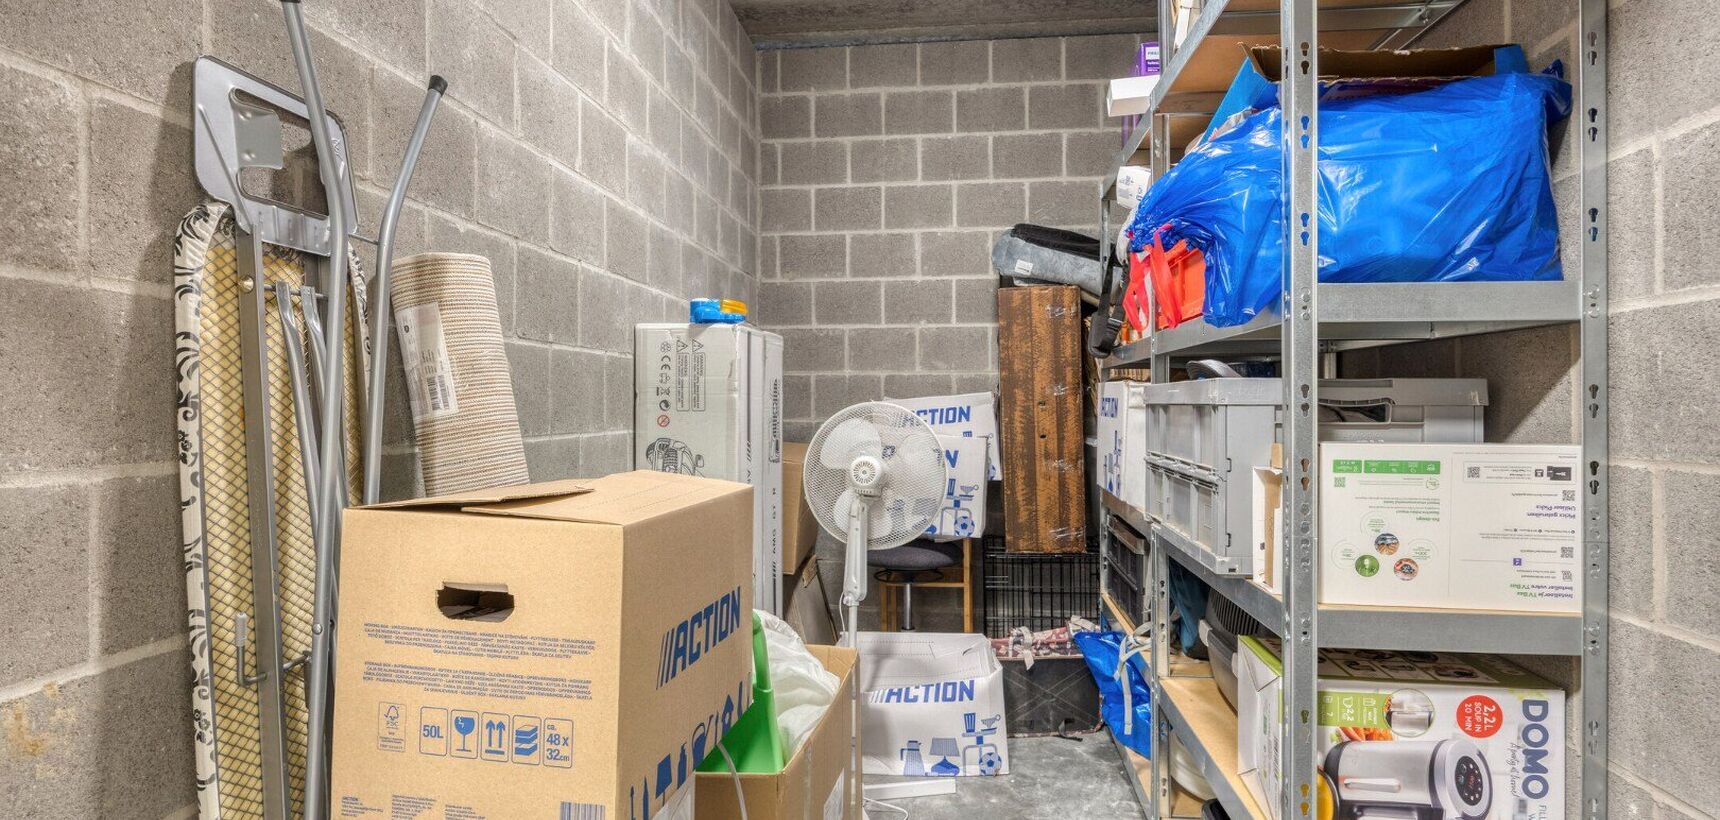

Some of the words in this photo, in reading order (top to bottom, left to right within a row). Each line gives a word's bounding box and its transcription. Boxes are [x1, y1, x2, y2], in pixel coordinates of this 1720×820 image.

[668, 586, 741, 682] ACTION
[885, 679, 975, 704] ACTION
[1465, 703, 1472, 713] 20
[1474, 702, 1482, 722] SOUP
[422, 725, 444, 739] 50L
[546, 734, 561, 745] 48
[1522, 699, 1549, 800] DOMO
